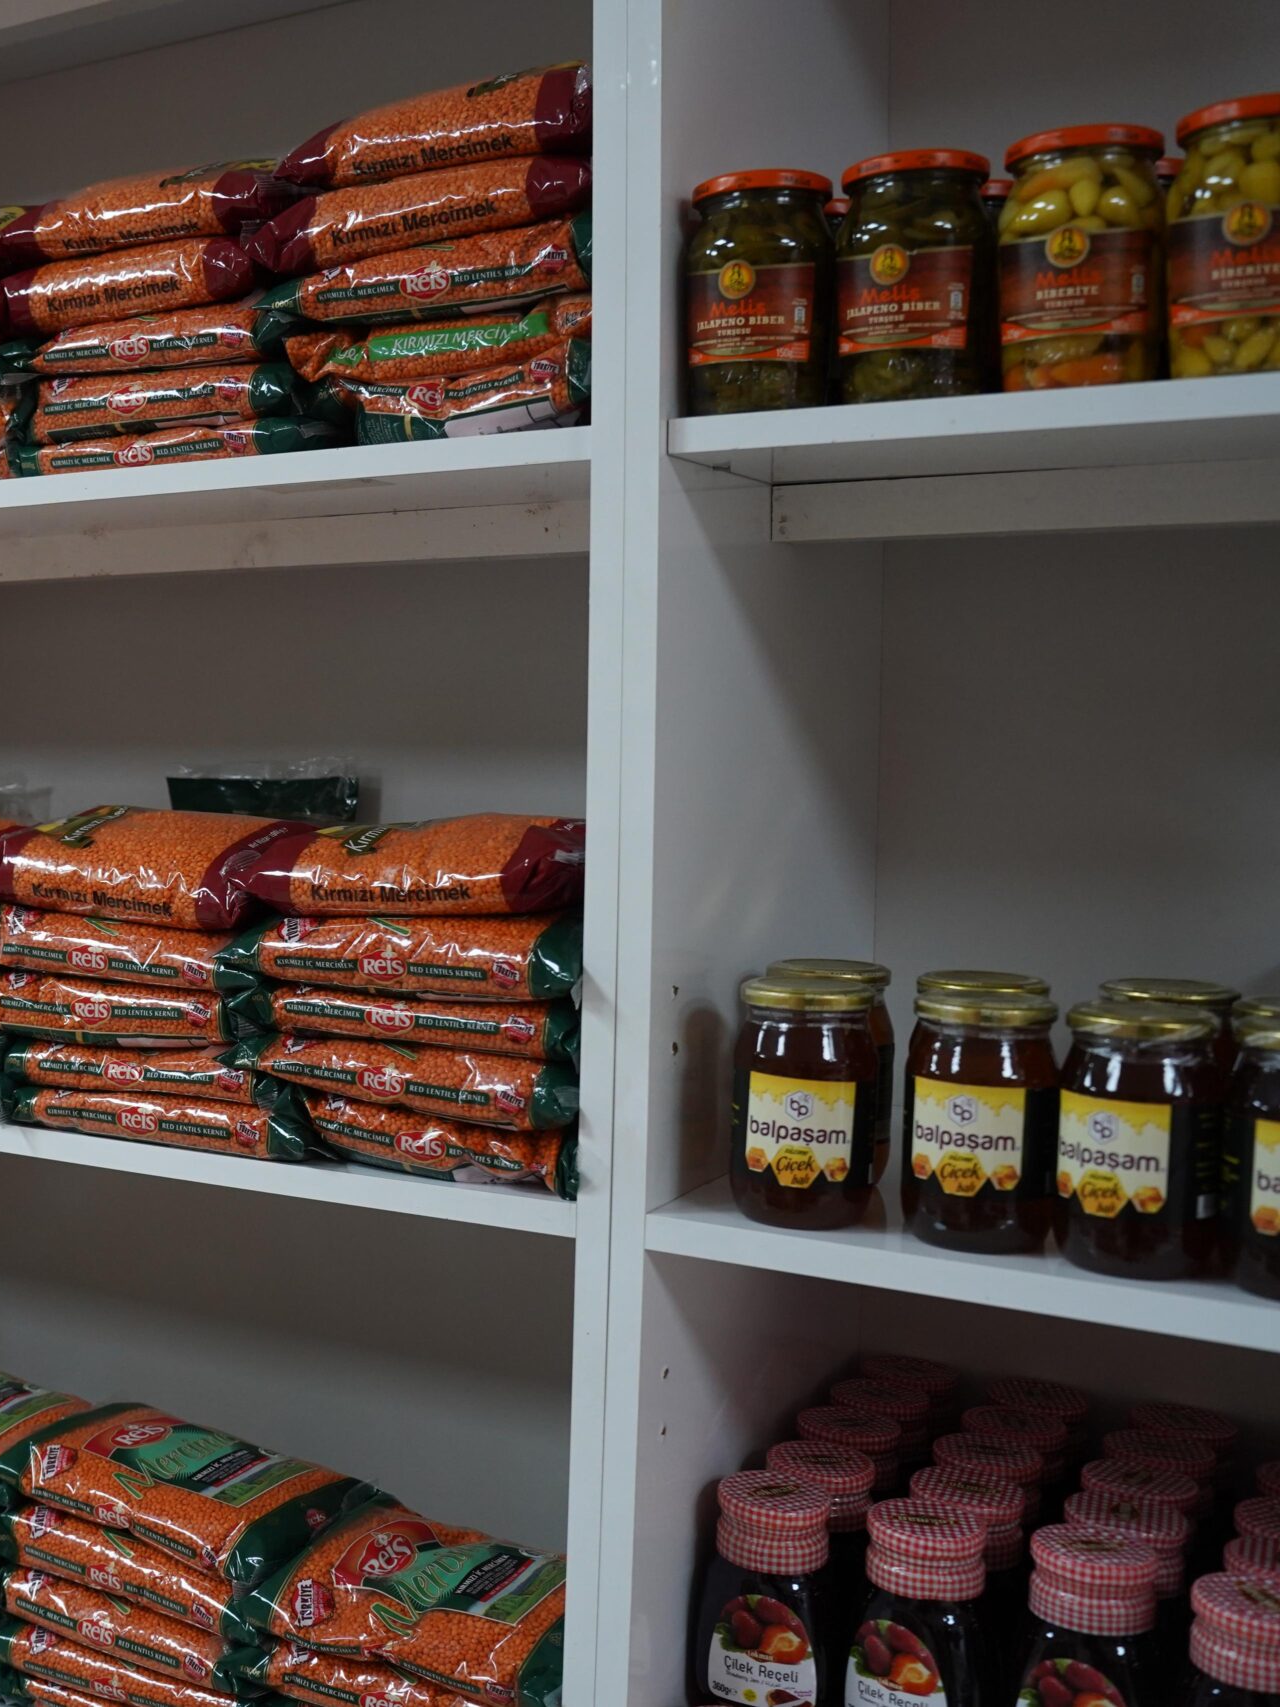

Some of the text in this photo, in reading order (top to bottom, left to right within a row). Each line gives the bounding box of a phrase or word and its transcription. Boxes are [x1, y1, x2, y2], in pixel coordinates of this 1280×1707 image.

[402, 200, 498, 233] Mercimek
[380, 885, 471, 903] Mercimek
[93, 890, 173, 917] Mercimek
[71, 951, 106, 969] Reis
[111, 961, 175, 976] RED KERNEL
[363, 959, 403, 975] Reis
[425, 967, 453, 976] LENTILS
[455, 969, 482, 978] KERNEL
[74, 1002, 109, 1019] Reis
[114, 1007, 178, 1018] RED LENTILS KERNEL
[286, 1003, 313, 1012] KIRMIZI
[418, 1018, 495, 1031] RED LENTILS KERNEL
[409, 1084, 456, 1098] RED LENTILS
[121, 1114, 156, 1131] Reis
[162, 1122, 227, 1137] RED LENTILS KERNEL
[750, 1115, 846, 1146] balpaşam
[362, 1537, 411, 1574] Reis
[89, 1568, 121, 1589] Reis
[82, 1622, 113, 1646] Reis
[118, 1640, 177, 1666] RED LENTILS KERNEL
[724, 1656, 798, 1683] Çilek Reçeli
